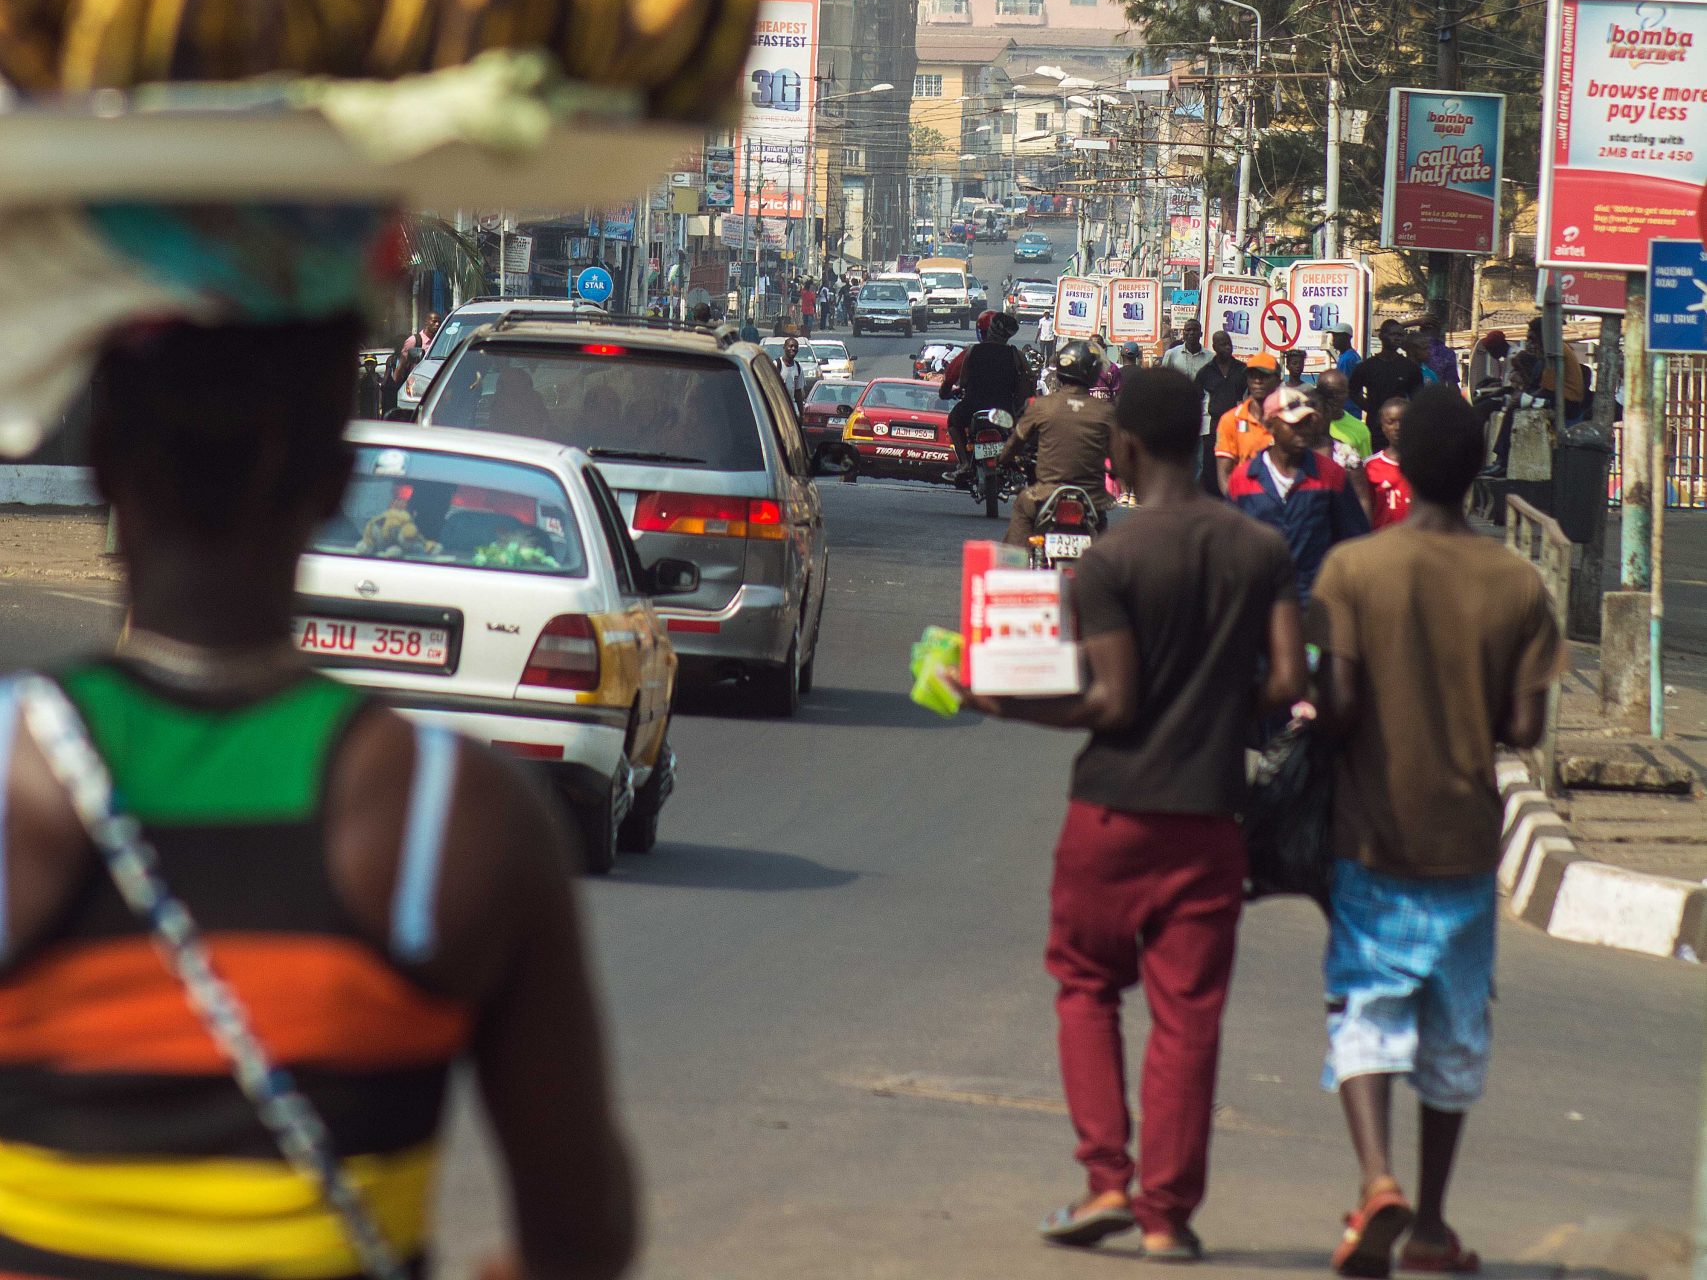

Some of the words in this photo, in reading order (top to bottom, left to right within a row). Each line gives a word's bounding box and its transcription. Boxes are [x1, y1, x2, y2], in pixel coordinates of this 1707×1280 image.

[757, 20, 807, 34] HEAPEST
[1611, 24, 1693, 47] bomba
[1609, 44, 1687, 62] internet
[1561, 55, 1573, 70] na
[752, 68, 801, 112] 3G
[1587, 79, 1659, 100] browse
[1428, 111, 1473, 124] bomba
[1606, 104, 1645, 123] pay
[1649, 102, 1687, 120] less
[1433, 124, 1466, 134] moni
[1609, 133, 1655, 146] starting
[1658, 134, 1685, 145] with
[1418, 146, 1456, 166] call
[1459, 145, 1482, 163] at
[1598, 147, 1627, 158] 2MB
[1631, 149, 1646, 159] at
[1650, 149, 1664, 160] Le
[1667, 151, 1694, 162] 450
[1410, 165, 1450, 186] half
[1452, 164, 1490, 180] rate
[1398, 232, 1416, 241] airtel
[1554, 244, 1586, 257] airtel
[1302, 273, 1349, 284] CHEAPEST
[585, 281, 604, 290] STAR
[1066, 283, 1094, 291] CHEAPEST
[1118, 283, 1150, 291] CHEAPEST
[1218, 284, 1260, 296] CHEAPEST
[1302, 286, 1349, 298] &FASTEST
[1065, 291, 1094, 299] &FASTEST
[1118, 291, 1150, 299] &FASTEST
[1217, 295, 1260, 307] &FASTEST
[1068, 300, 1087, 317] 3G
[1122, 302, 1144, 320] 3G
[1222, 309, 1250, 335] 3G
[1309, 302, 1339, 331] 3G
[876, 425, 886, 433] PL
[875, 446, 903, 457] THANK
[921, 450, 949, 462] JESUS
[1057, 535, 1079, 546] AJM
[1056, 546, 1078, 556] 413
[301, 621, 356, 650] AJU
[372, 628, 421, 656] 358
